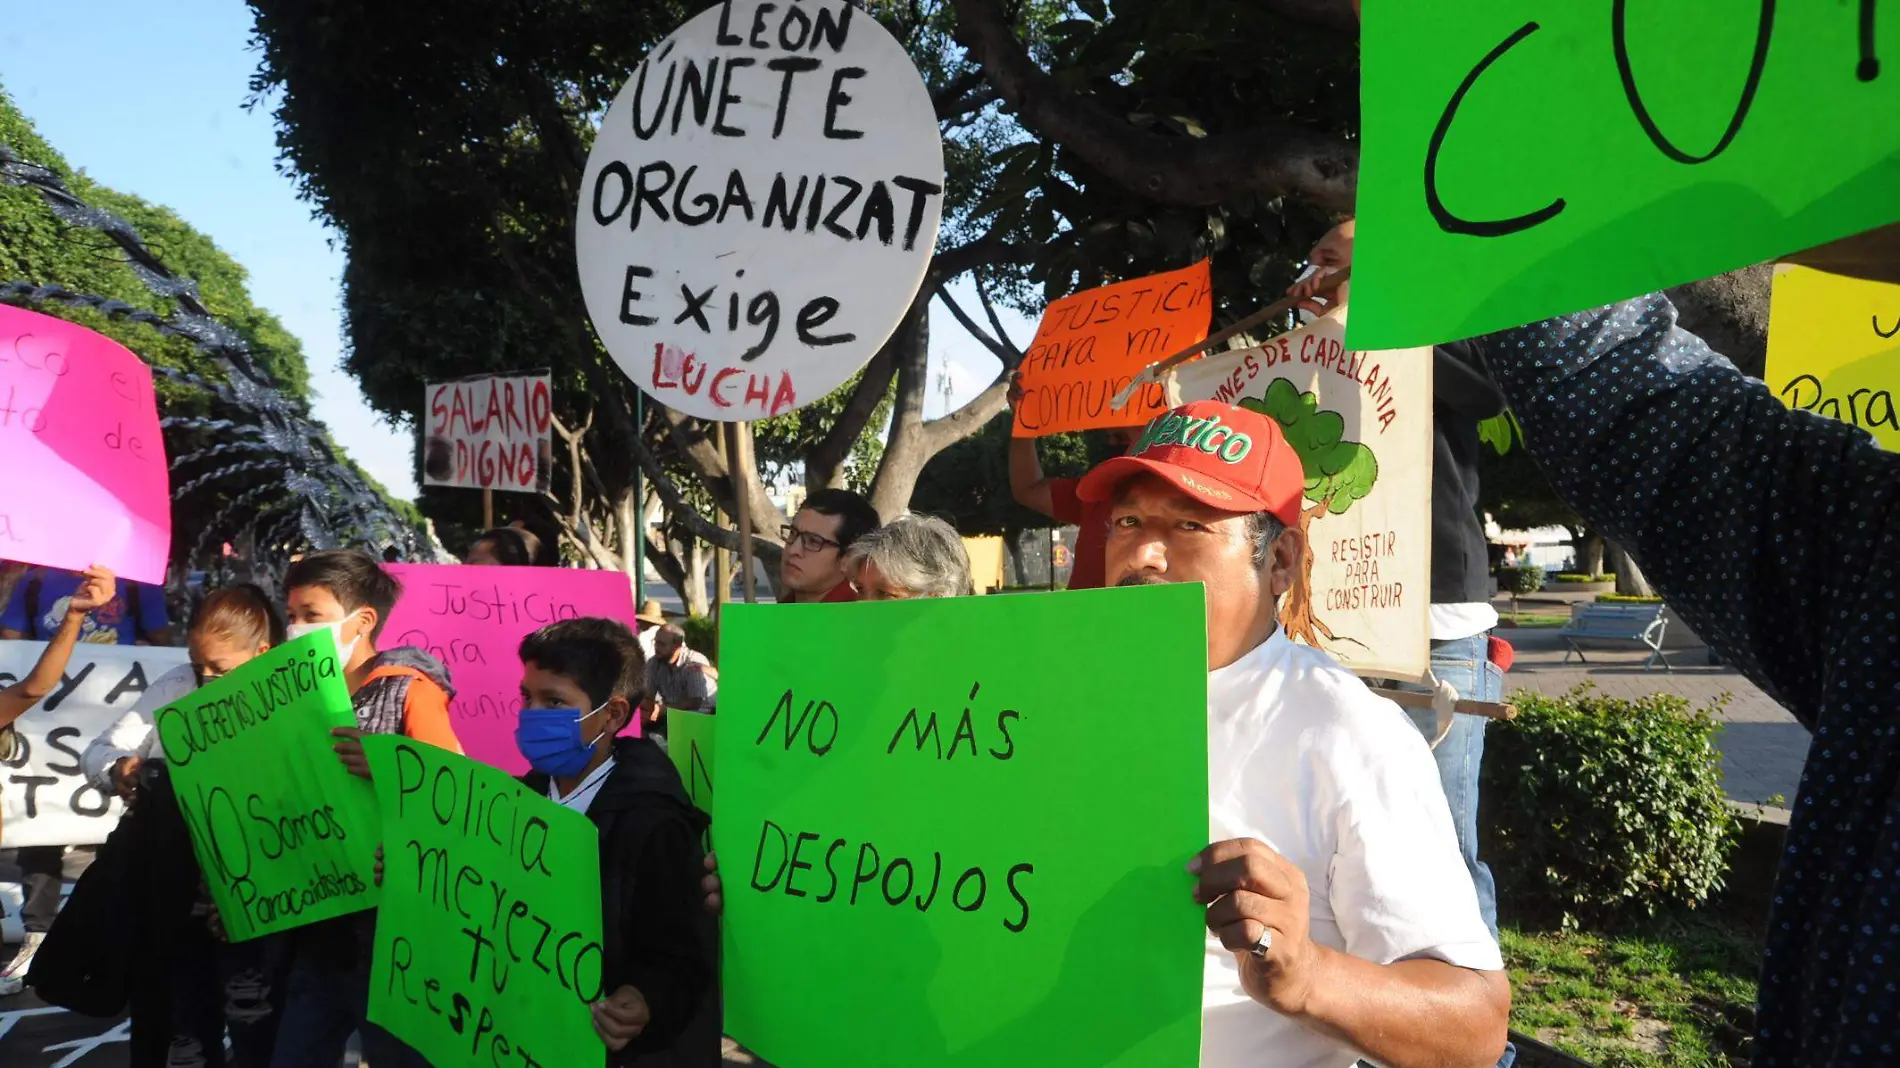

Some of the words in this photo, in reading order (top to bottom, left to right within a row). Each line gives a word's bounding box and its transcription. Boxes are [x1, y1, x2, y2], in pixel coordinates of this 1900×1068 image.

[632, 40, 867, 140] ÚNETE
[593, 160, 942, 251] ORGANIZAT
[620, 265, 856, 362] Exige
[1126, 325, 1175, 357] mi
[431, 379, 551, 442] SALARIO
[652, 342, 796, 417] LUCHA
[1264, 338, 1292, 368] DE
[1300, 334, 1397, 435] CAPELLANIA
[456, 438, 535, 487] DIGNO
[1331, 530, 1396, 563] RESISTIR
[1344, 559, 1380, 585] PARA
[429, 583, 580, 625] Justicia
[1326, 581, 1403, 611] CONSTRUIR
[397, 629, 486, 666] Para
[755, 688, 839, 757] NO
[887, 681, 1020, 760] MÁS
[180, 783, 251, 887] NO
[247, 793, 347, 860] Somos
[750, 819, 1034, 932] DESPOJOS
[461, 923, 509, 995] tu
